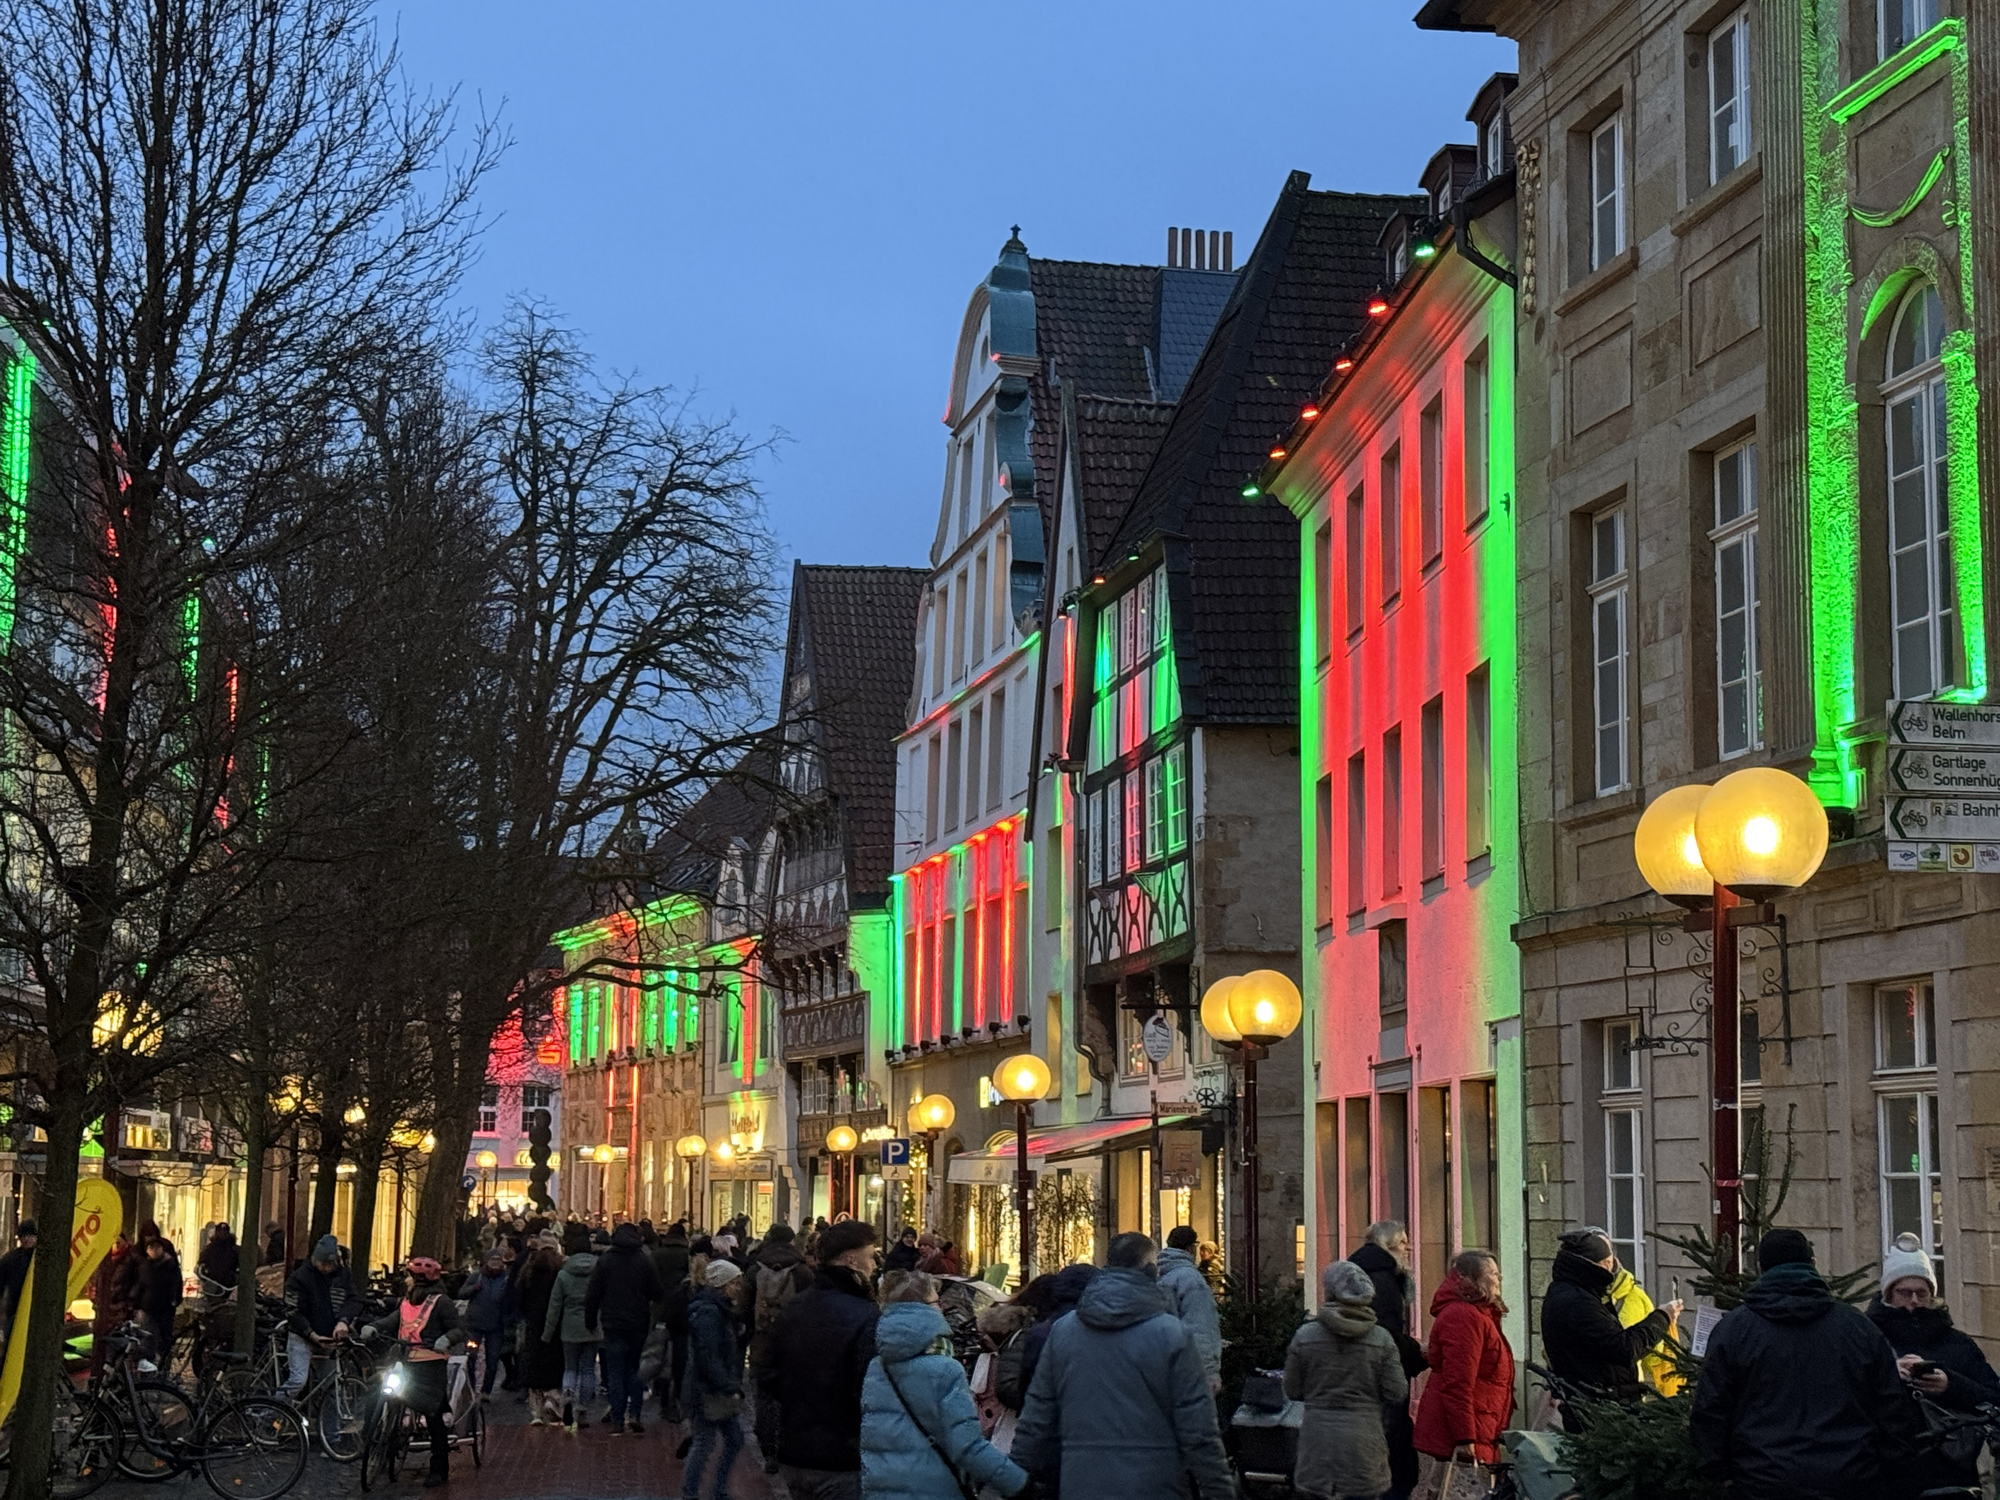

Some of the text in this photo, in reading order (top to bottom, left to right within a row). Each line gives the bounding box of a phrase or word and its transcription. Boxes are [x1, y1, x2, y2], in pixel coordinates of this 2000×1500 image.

[1933, 725, 1966, 739] Belm
[1932, 755, 1986, 772] Gartlage
[887, 1142, 904, 1164] P
[70, 1214, 100, 1267] TTO
